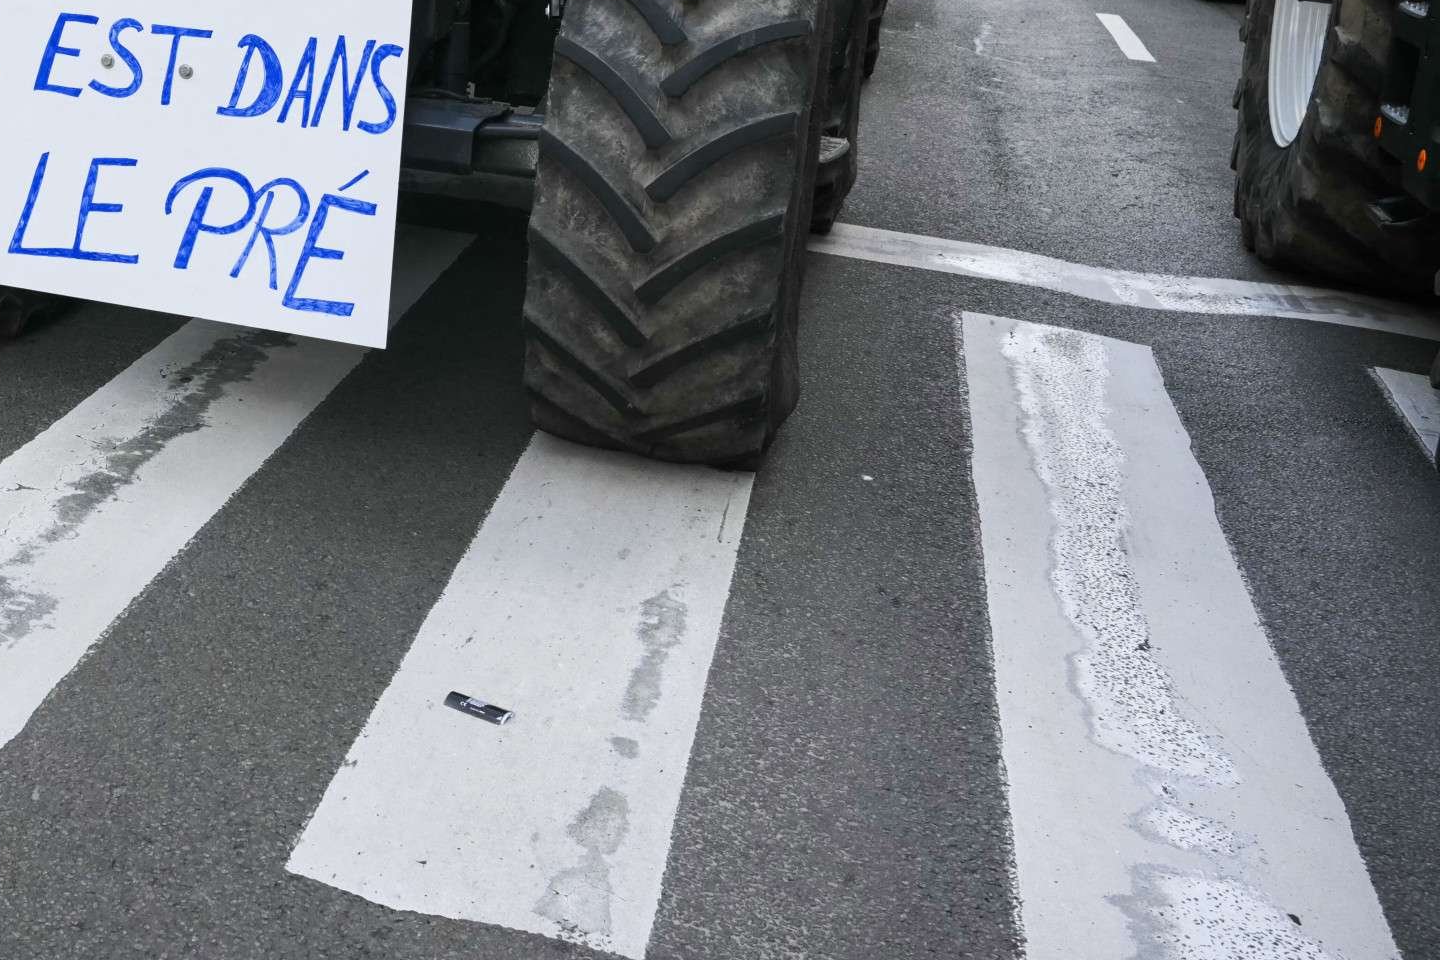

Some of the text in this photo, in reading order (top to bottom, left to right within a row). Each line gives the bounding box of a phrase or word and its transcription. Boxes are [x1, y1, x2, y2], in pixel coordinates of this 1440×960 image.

[33, 11, 404, 136] EST DANS
[7, 151, 379, 318] LE PRÉ
